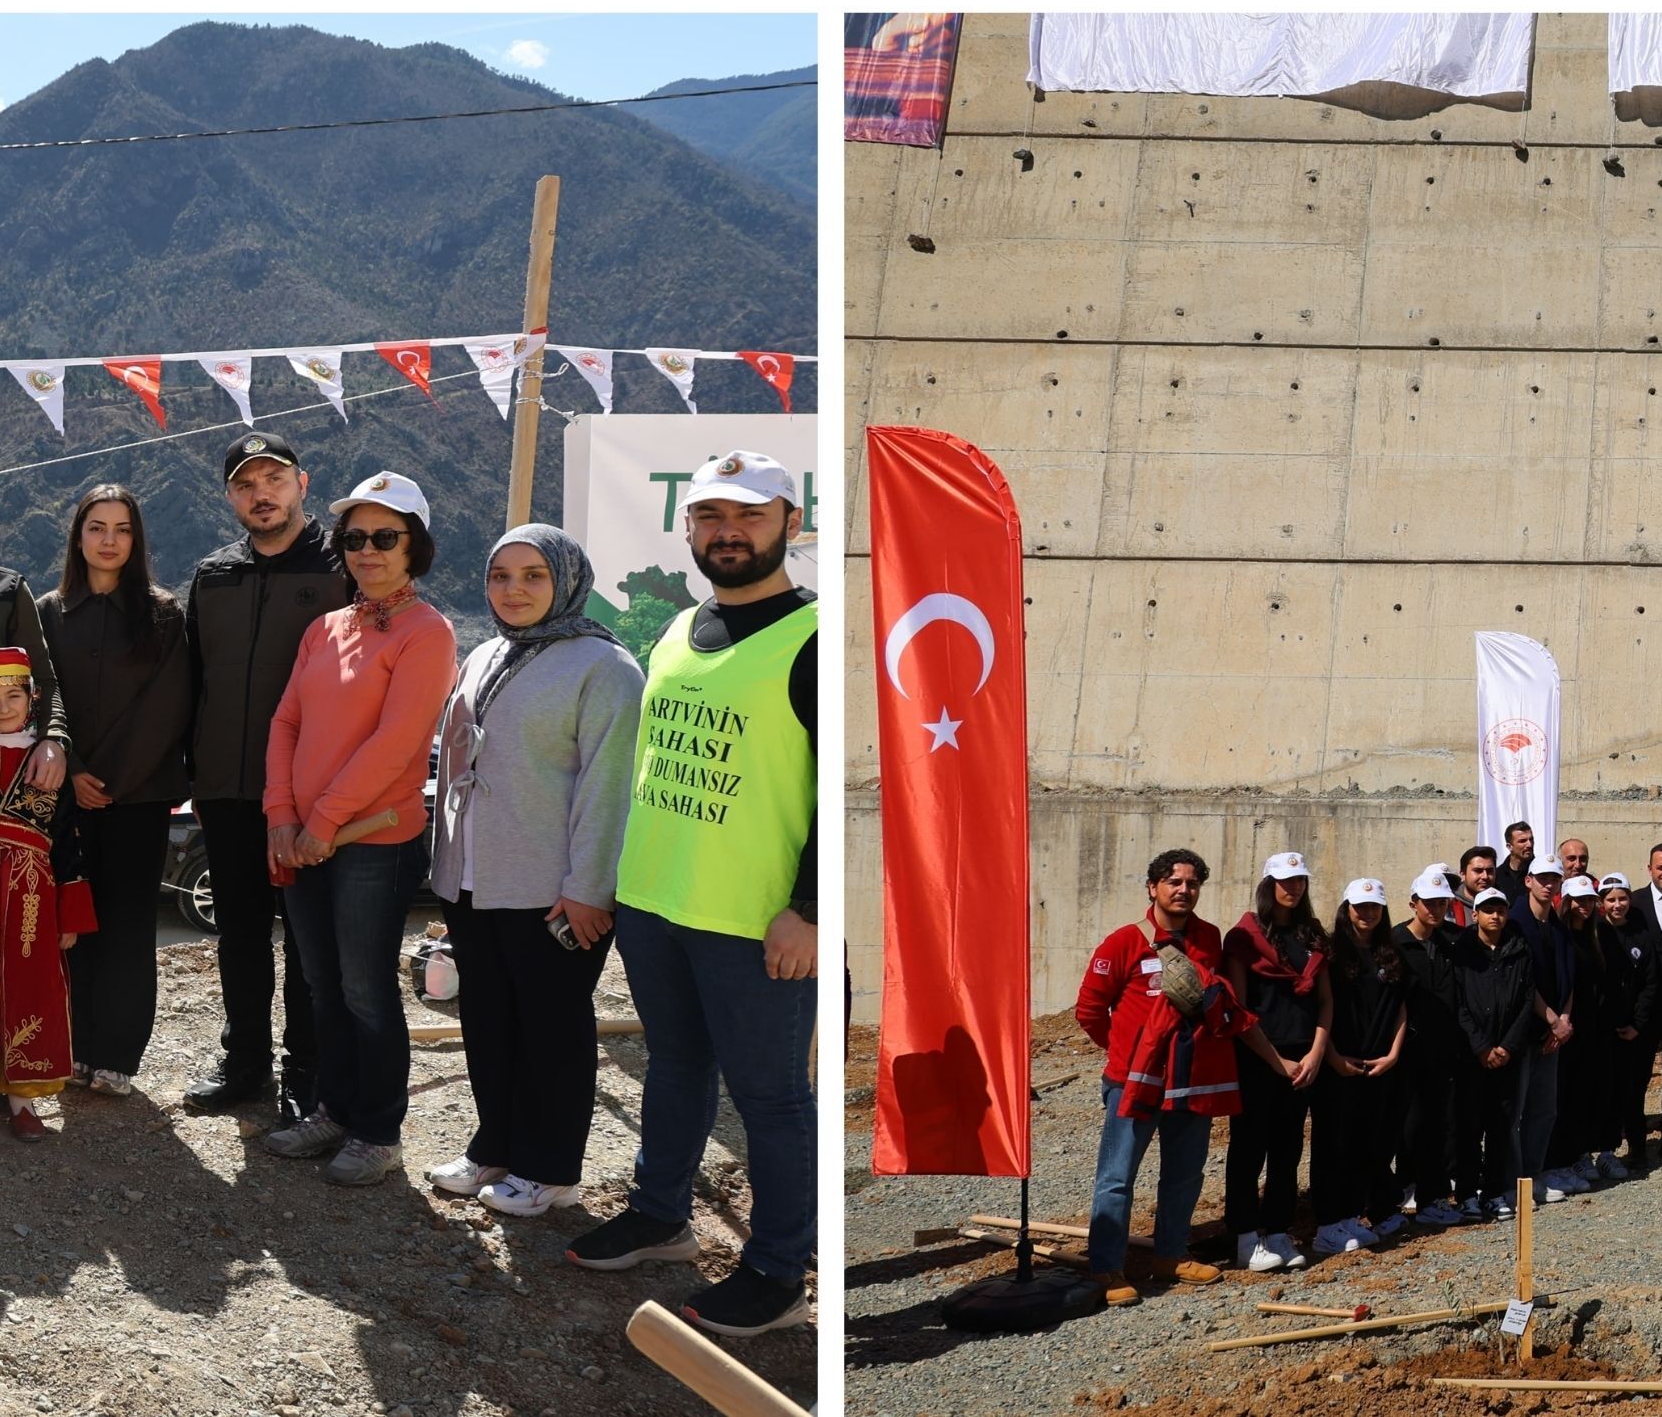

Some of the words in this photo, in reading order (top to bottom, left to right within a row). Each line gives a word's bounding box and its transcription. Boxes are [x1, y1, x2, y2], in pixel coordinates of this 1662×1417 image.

[648, 696, 750, 738] ARTVİNİN
[648, 725, 734, 763] SAHASI
[654, 756, 742, 797] DUMANSIZ
[659, 789, 730, 825] SAHASI
